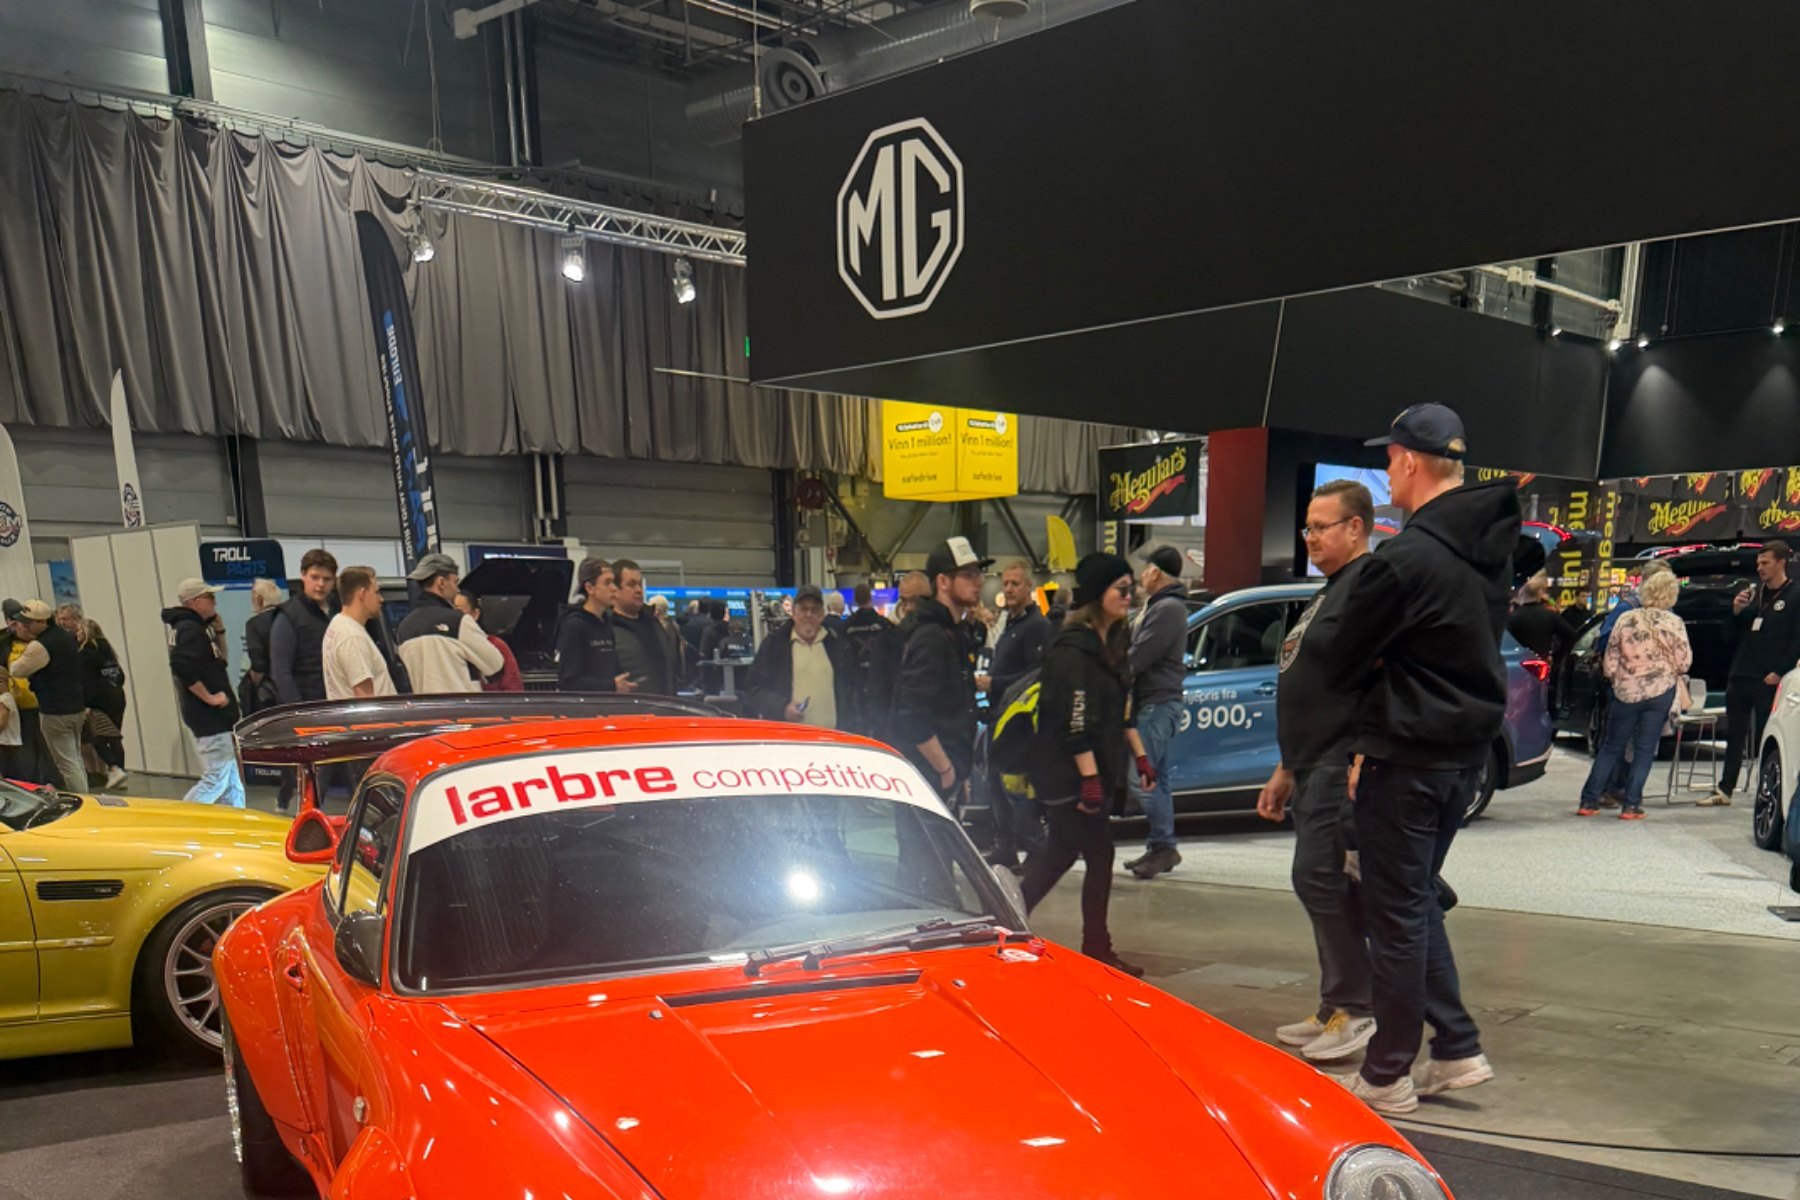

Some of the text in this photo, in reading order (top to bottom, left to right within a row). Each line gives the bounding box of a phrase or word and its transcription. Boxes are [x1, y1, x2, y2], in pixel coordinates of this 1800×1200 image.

[849, 138, 951, 301] MG
[212, 546, 252, 562] TROLL
[226, 560, 267, 575] PARTS
[1197, 704, 1262, 729] 900,-
[445, 761, 913, 826] larbre compétition
